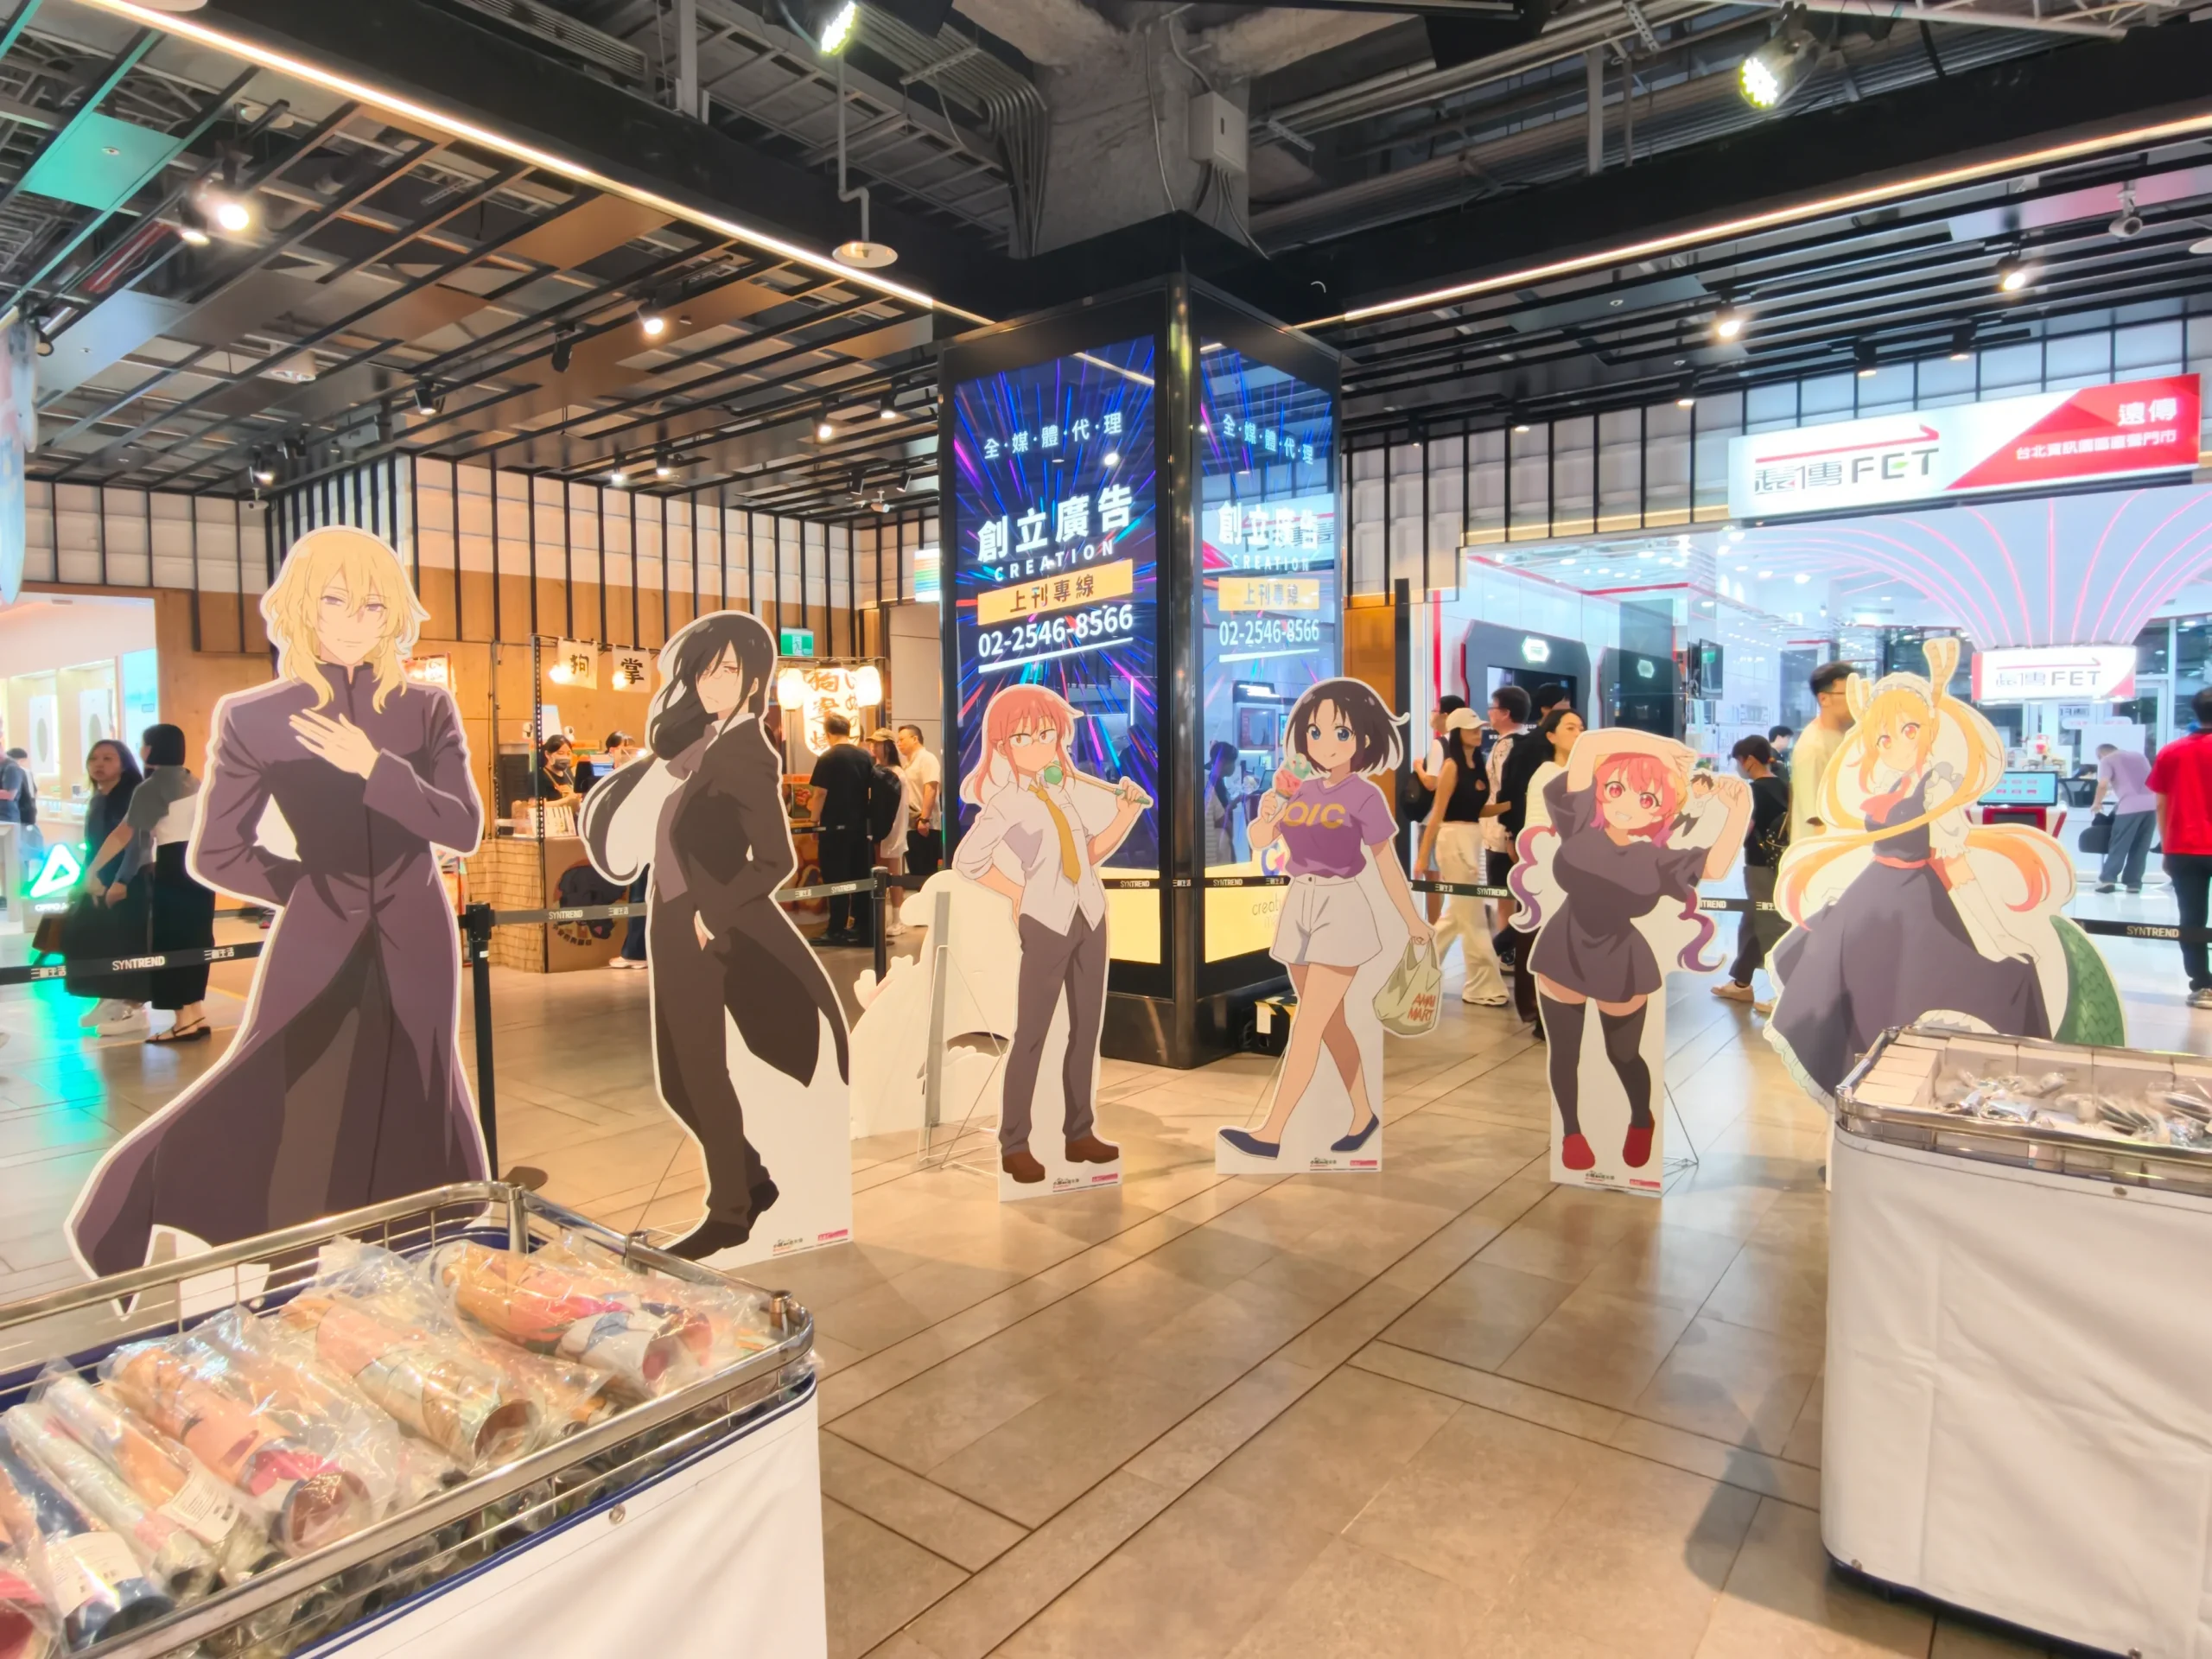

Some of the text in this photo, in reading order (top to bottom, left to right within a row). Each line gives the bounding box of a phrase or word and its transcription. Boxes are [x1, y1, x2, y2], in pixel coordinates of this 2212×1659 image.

[1852, 448, 1939, 484] FET
[977, 484, 1133, 563] 創立廣告
[995, 539, 1115, 582] CREATION
[1232, 555, 1309, 571] CREATION
[1010, 574, 1094, 613] 上刊專線
[979, 604, 1133, 658] 02-2546-8566
[1219, 619, 1319, 646] 02-2546-8566
[620, 658, 645, 684] 掌
[2051, 671, 2101, 687] FET
[1213, 878, 1243, 887] SYNTREND
[1477, 887, 1508, 897] SYNTREND
[549, 910, 583, 920] SYNTREND
[2126, 925, 2179, 938] SYNTREND
[111, 956, 165, 971] SYNTREND
